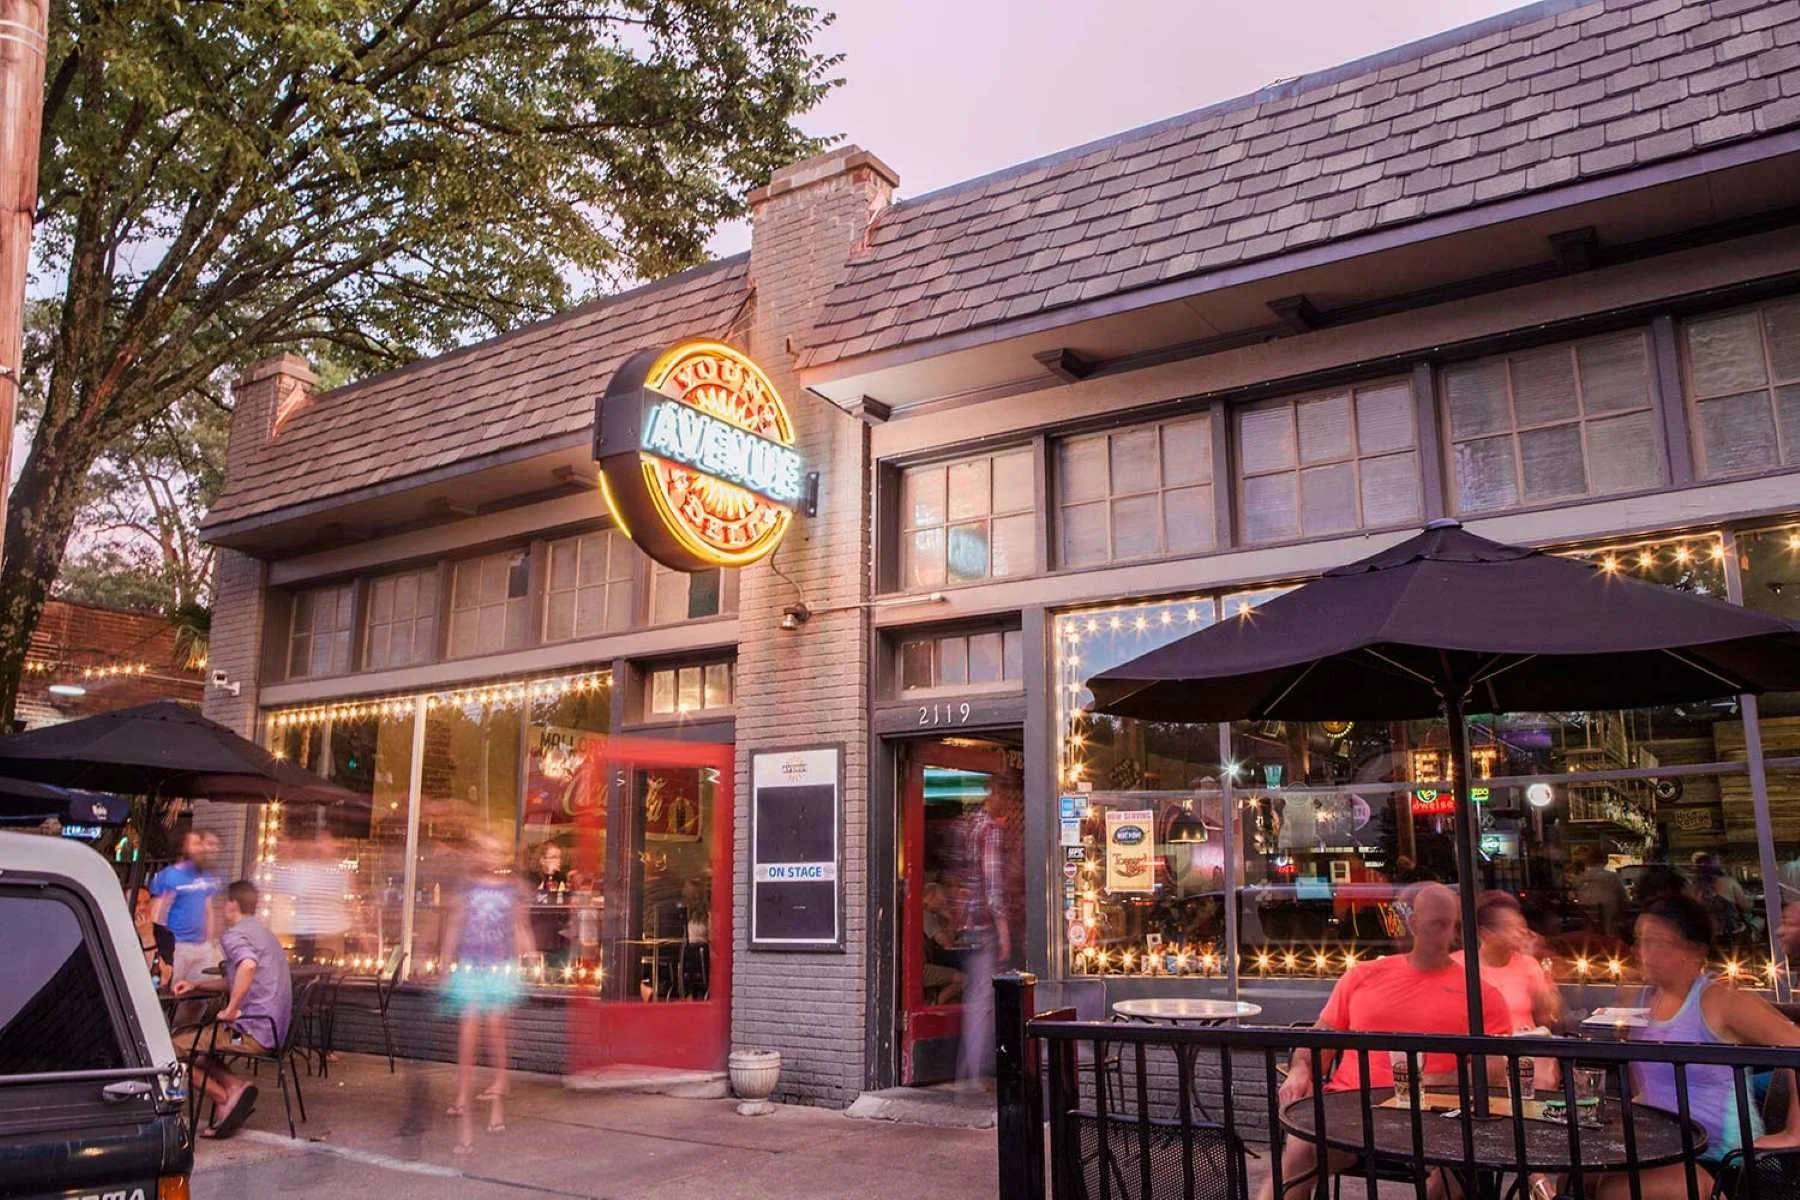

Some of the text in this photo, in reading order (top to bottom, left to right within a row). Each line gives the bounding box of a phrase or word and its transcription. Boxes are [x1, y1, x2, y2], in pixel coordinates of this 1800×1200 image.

[676, 358, 778, 430] YOUNG
[643, 402, 801, 500] AVENUE
[682, 493, 763, 544] DELI
[918, 702, 970, 726] 2119
[768, 866, 823, 878] ON STAGE
